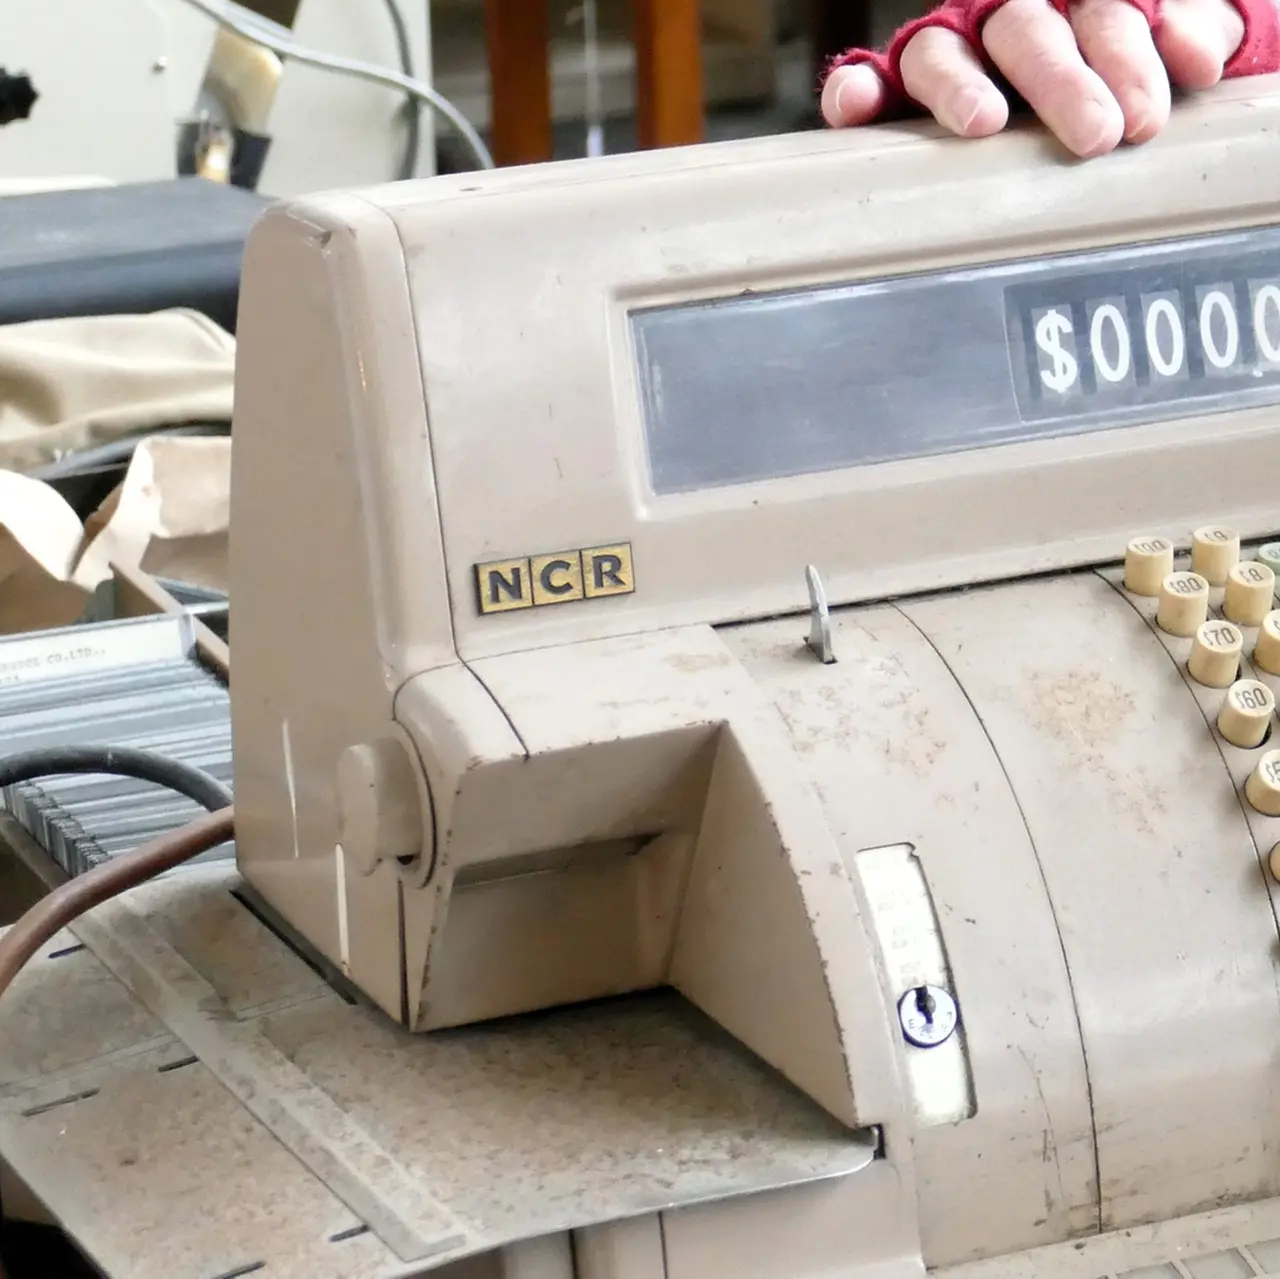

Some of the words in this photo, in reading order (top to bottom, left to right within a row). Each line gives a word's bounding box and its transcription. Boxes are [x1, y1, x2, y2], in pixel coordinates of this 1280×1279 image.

[489, 554, 626, 603] NCR
[1239, 568, 1263, 582] $8
[1169, 577, 1202, 594] $80
[1203, 627, 1236, 646] $70
[1235, 687, 1268, 709] $60
